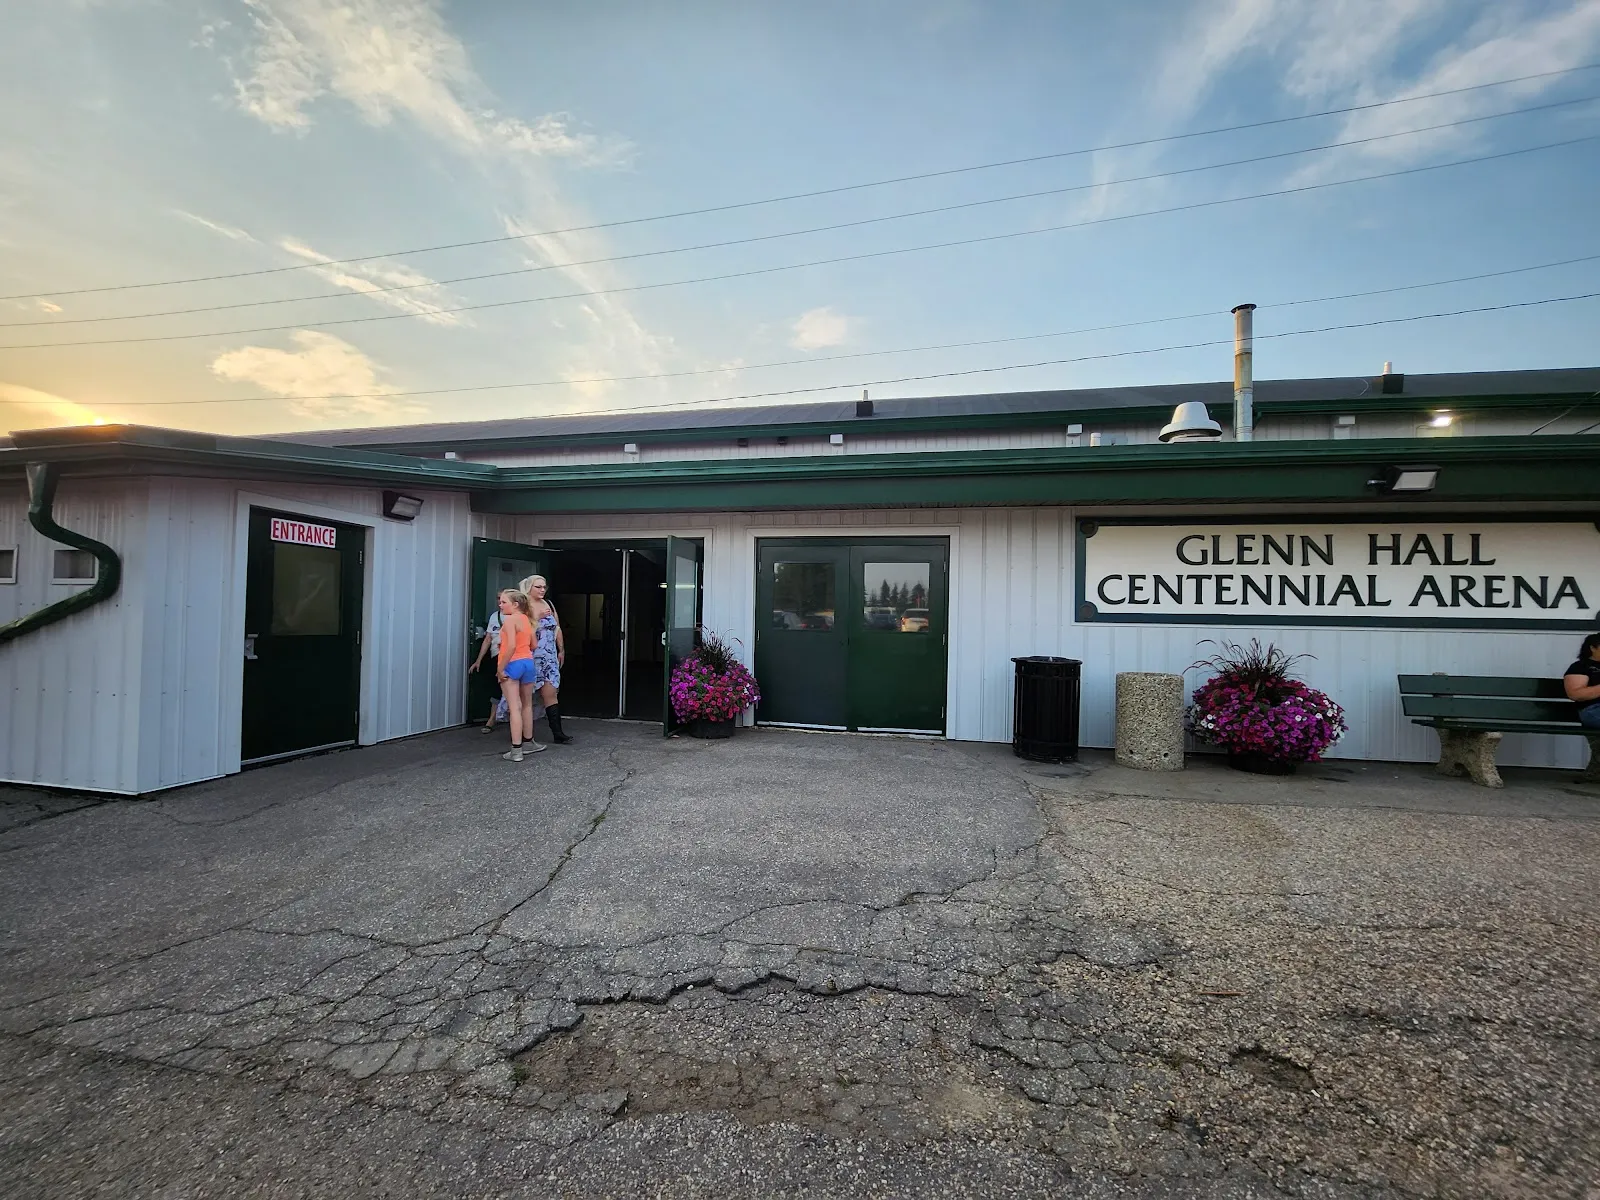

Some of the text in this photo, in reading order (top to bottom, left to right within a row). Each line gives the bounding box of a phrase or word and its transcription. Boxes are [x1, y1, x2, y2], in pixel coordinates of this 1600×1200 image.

[272, 520, 335, 546] ENTRANCE
[1176, 533, 1496, 567] GLENN HALL
[1097, 574, 1590, 609] CENTENNIAL ARENA
